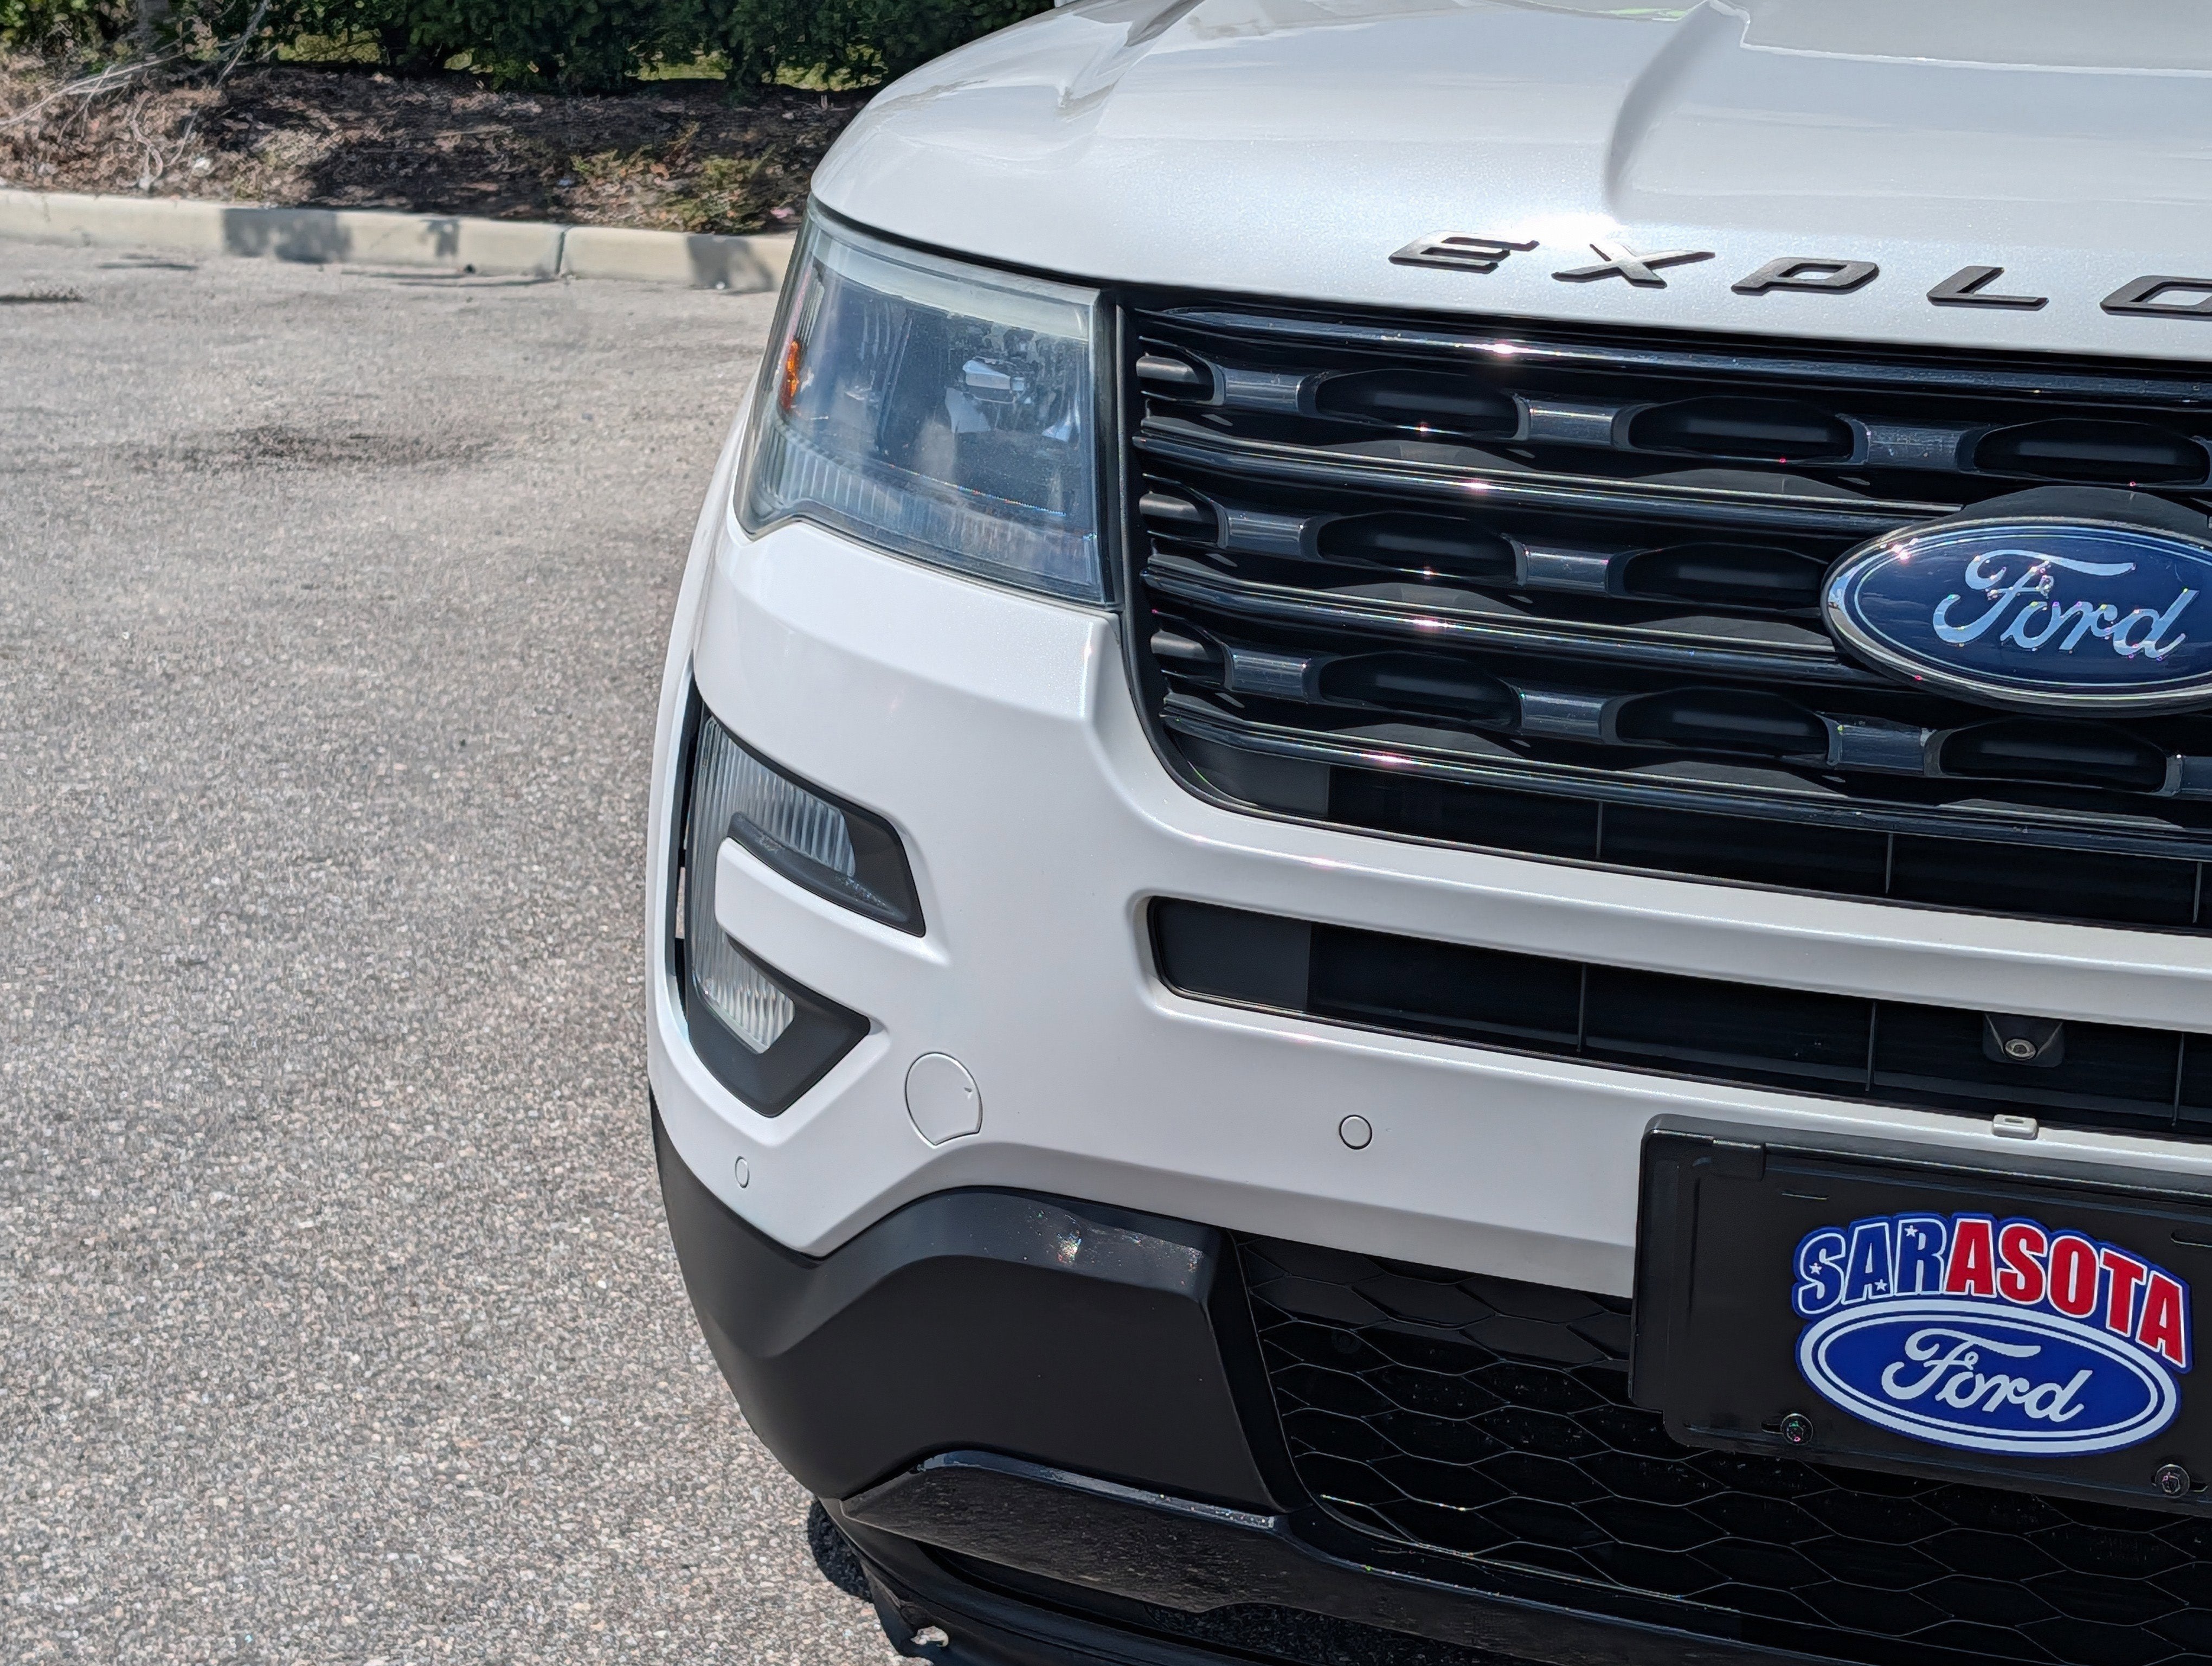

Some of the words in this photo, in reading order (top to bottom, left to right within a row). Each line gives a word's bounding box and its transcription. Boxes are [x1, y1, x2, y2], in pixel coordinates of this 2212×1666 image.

[1933, 549, 2200, 659] Ford
[1798, 1218, 2187, 1368] SARASOTA
[1881, 1328, 2093, 1422] Ford
